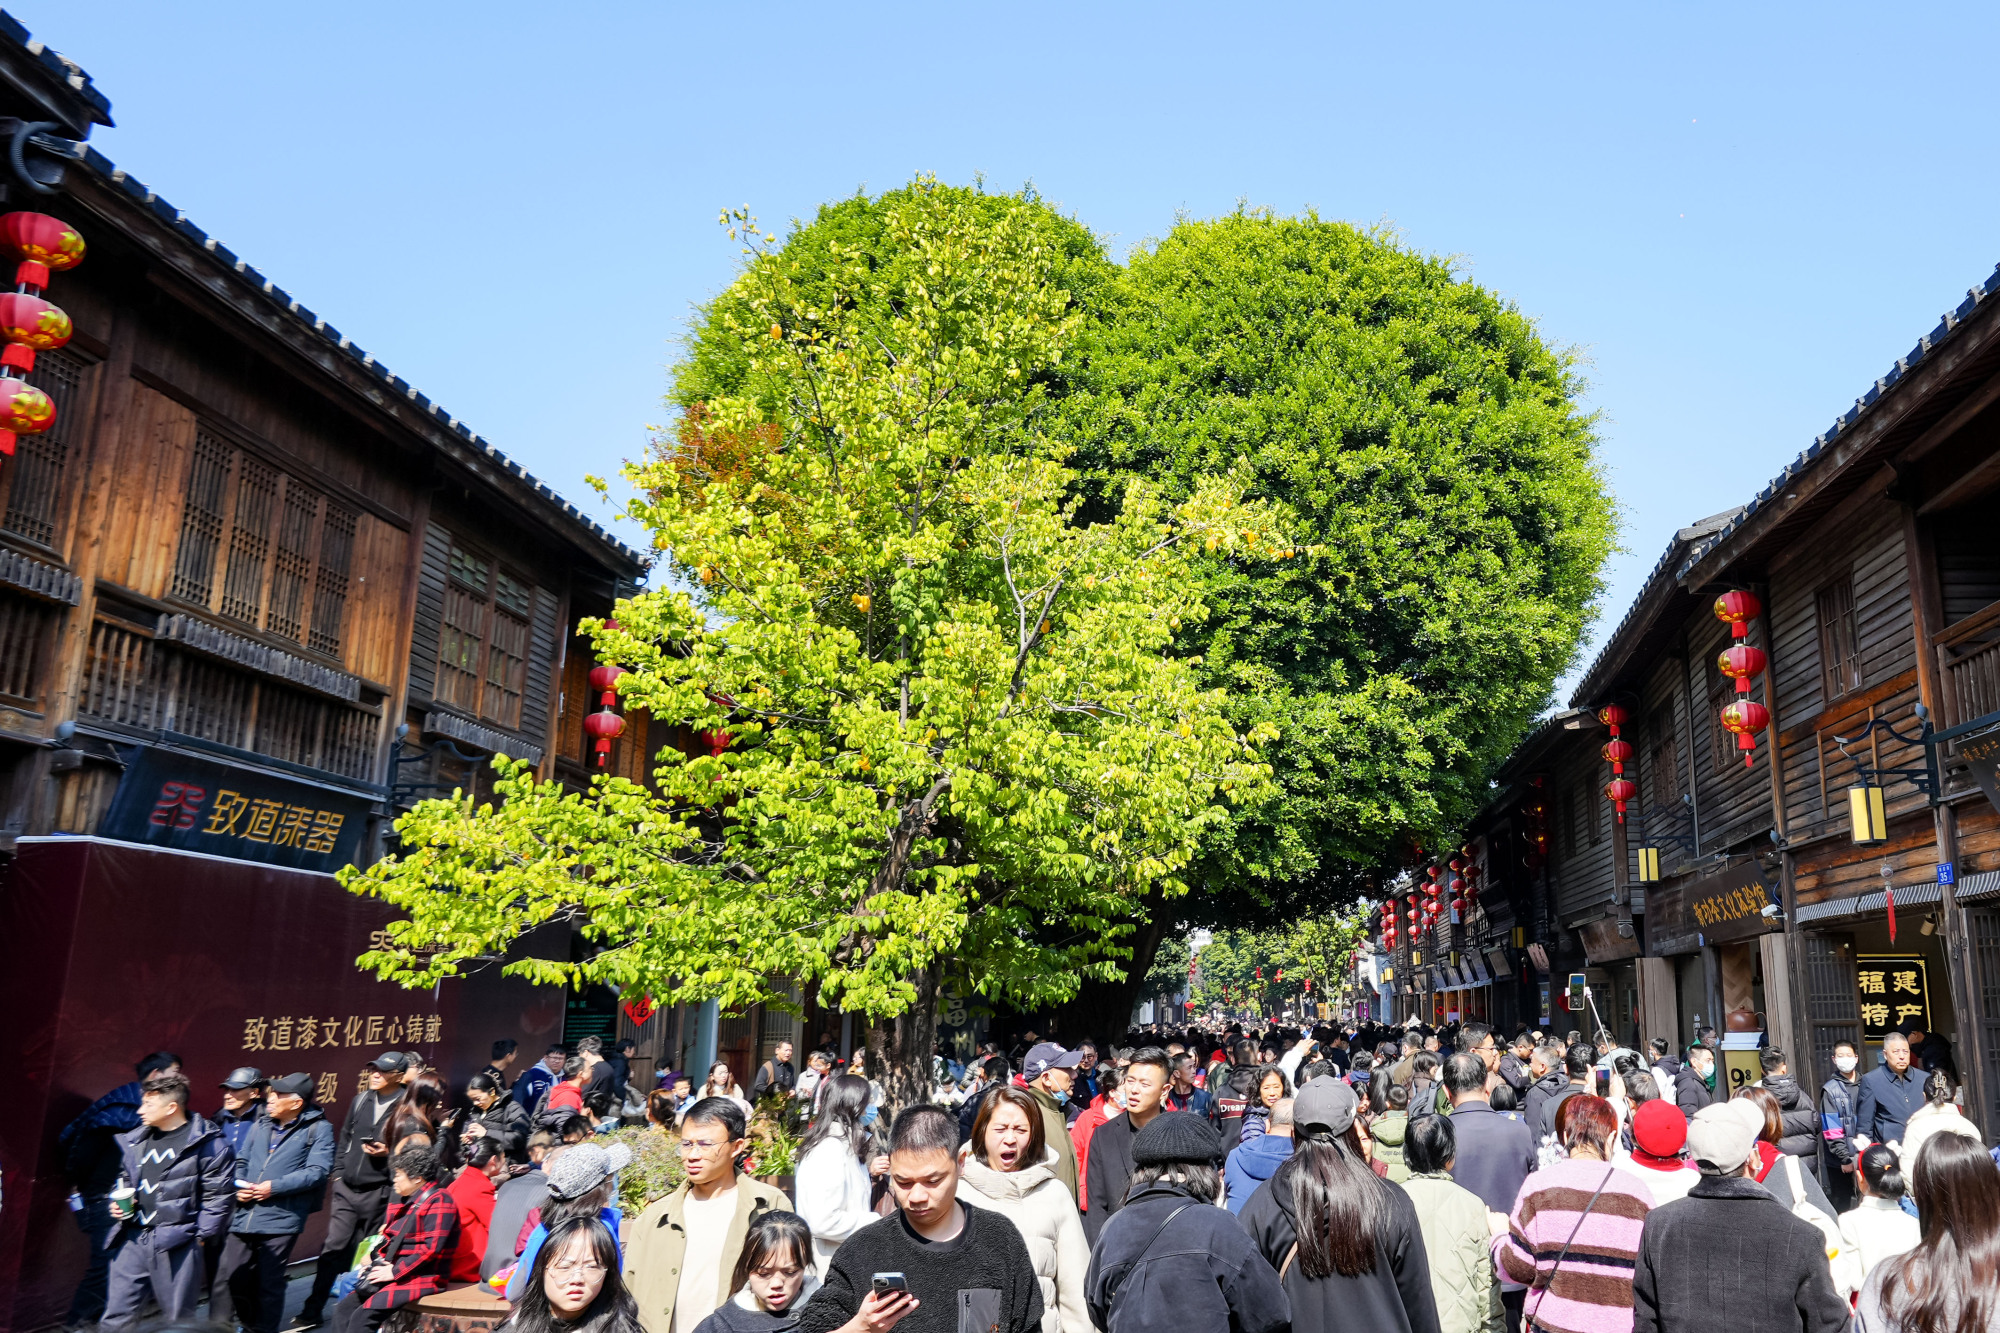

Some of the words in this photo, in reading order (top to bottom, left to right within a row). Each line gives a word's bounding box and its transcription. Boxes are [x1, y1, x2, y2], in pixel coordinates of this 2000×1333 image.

[202, 789, 345, 854] 致道漆器
[1940, 872, 1947, 882] 35
[1859, 971, 1921, 995] 福建
[1861, 1003, 1923, 1026] 特产
[242, 1014, 443, 1052] 致道漆文化匠心铸就
